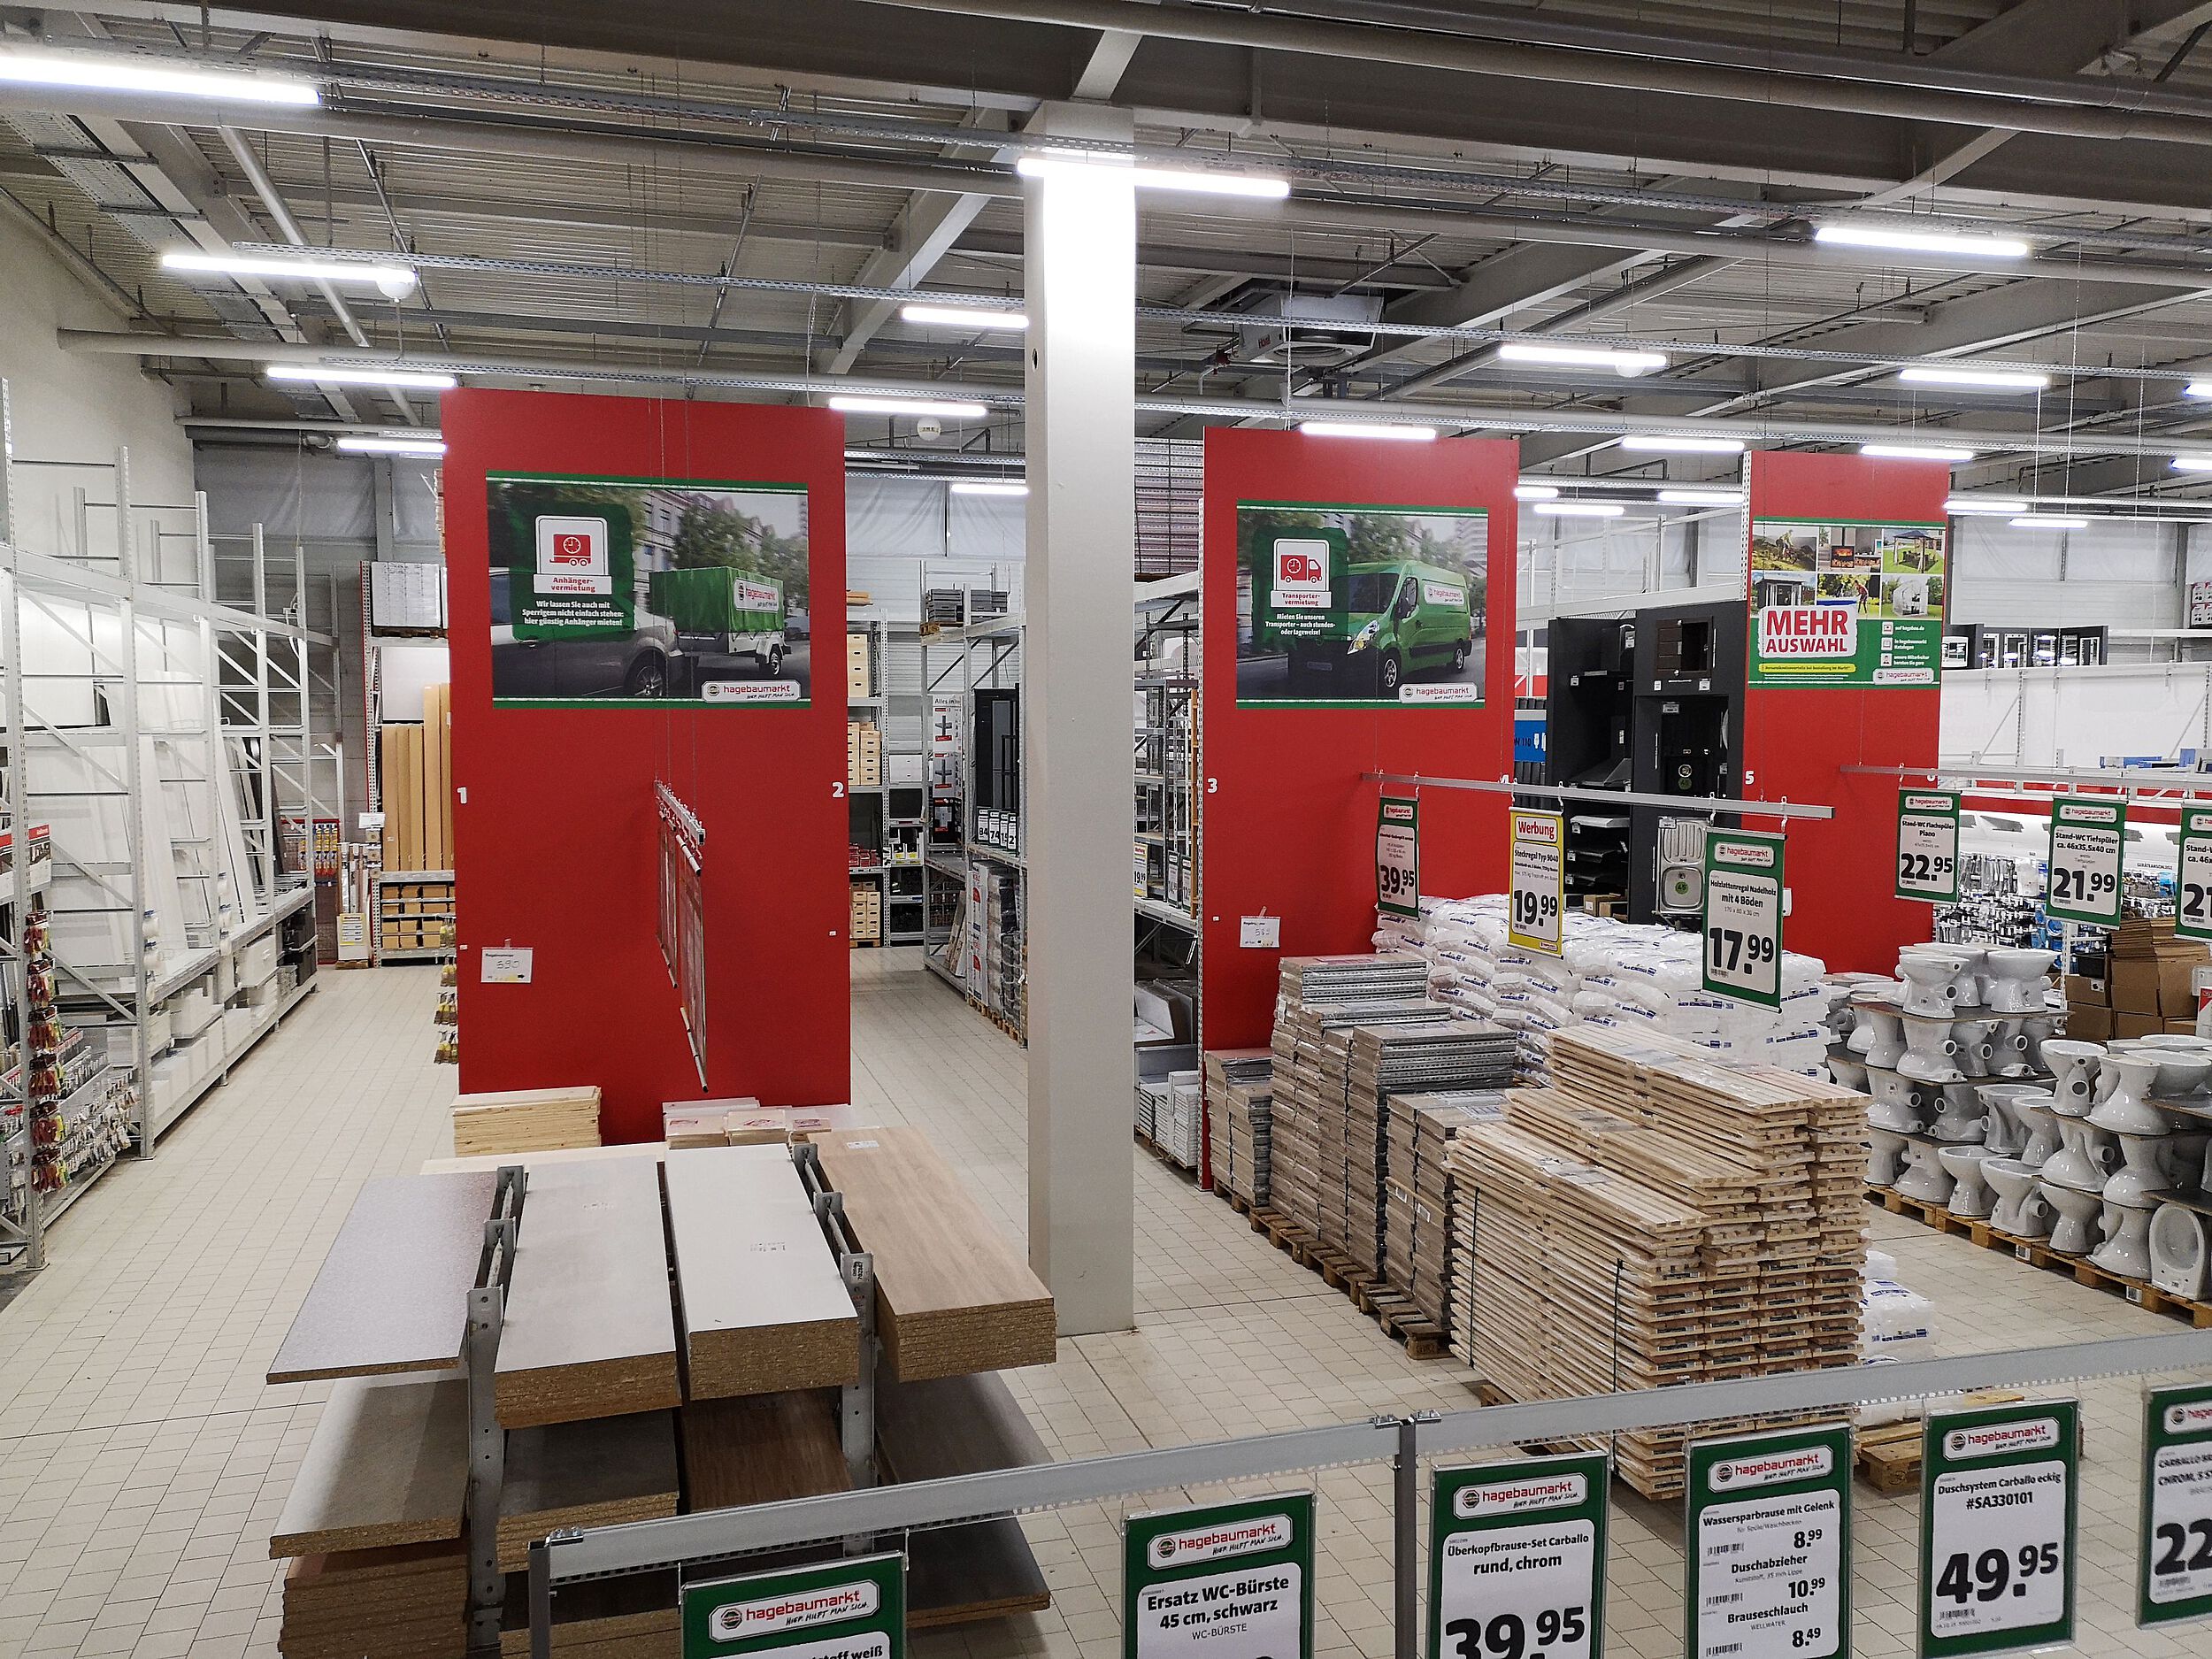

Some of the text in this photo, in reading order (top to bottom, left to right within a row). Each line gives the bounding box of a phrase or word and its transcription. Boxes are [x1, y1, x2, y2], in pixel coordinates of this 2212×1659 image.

[551, 584, 595, 593] vermietung
[1766, 610, 1848, 635] MEHR
[1765, 638, 1847, 653] AUSWAHL
[723, 685, 790, 694] hagebaumarkt
[1207, 778, 1218, 793] 3
[1745, 770, 1755, 785] 5
[457, 787, 467, 803] 1
[833, 782, 844, 797] 2
[1517, 821, 1555, 840] Werbung
[2055, 832, 2118, 845] Stand-WC Tiefspüler
[1514, 849, 1538, 861] Steckregal
[1538, 852, 1547, 863] Typ
[1726, 847, 1769, 857] hagebaumarkt
[1901, 853, 1953, 881] 22.95
[1379, 864, 1415, 895] 39.95
[1710, 879, 1777, 896] Holzlattenregal Nadelholz
[2053, 867, 2116, 902] 21.99
[1513, 889, 1558, 926] 19.99
[1721, 893, 1733, 903] mit
[1740, 895, 1763, 908] Böden
[1709, 927, 1774, 974] 17.99
[1968, 1425, 2046, 1445] hagebaumarkt
[1735, 1453, 1819, 1475] hagebaumarkt
[1482, 1481, 1572, 1502] hagebaumarkt
[1938, 1472, 2062, 1494] Duschsystem Carballo eckig
[1966, 1491, 2033, 1510] #SA330101
[1702, 1509, 1786, 1527] Wassersparbrause
[1786, 1504, 1802, 1515] mit
[1803, 1501, 1835, 1512] Gelenk
[1179, 1524, 1276, 1549] hagebaumarkt
[1229, 1540, 1249, 1551] HILFT
[1250, 1537, 1266, 1547] MAN
[1448, 1533, 1589, 1557] Überkopfbrause-Set Carballo
[1793, 1528, 1823, 1548] 8.99
[1473, 1555, 1563, 1575] rund, chrom
[1731, 1555, 1809, 1574] Duschabzieher
[1935, 1541, 2059, 1604] 49.95
[1148, 1576, 1289, 1611] Ersatz WC-Bürste
[1788, 1577, 1825, 1599] 10.99
[746, 1590, 860, 1621] hagebaumarkt
[1159, 1599, 1279, 1630] 45 cm, schwarz
[1727, 1602, 1809, 1624] Brauseschlauch
[1192, 1622, 1248, 1640] WC-BÜRSTE
[1750, 1620, 1786, 1631] WELLWATER
[1792, 1627, 1821, 1648] 8.49
[850, 1645, 883, 1659] weiß
